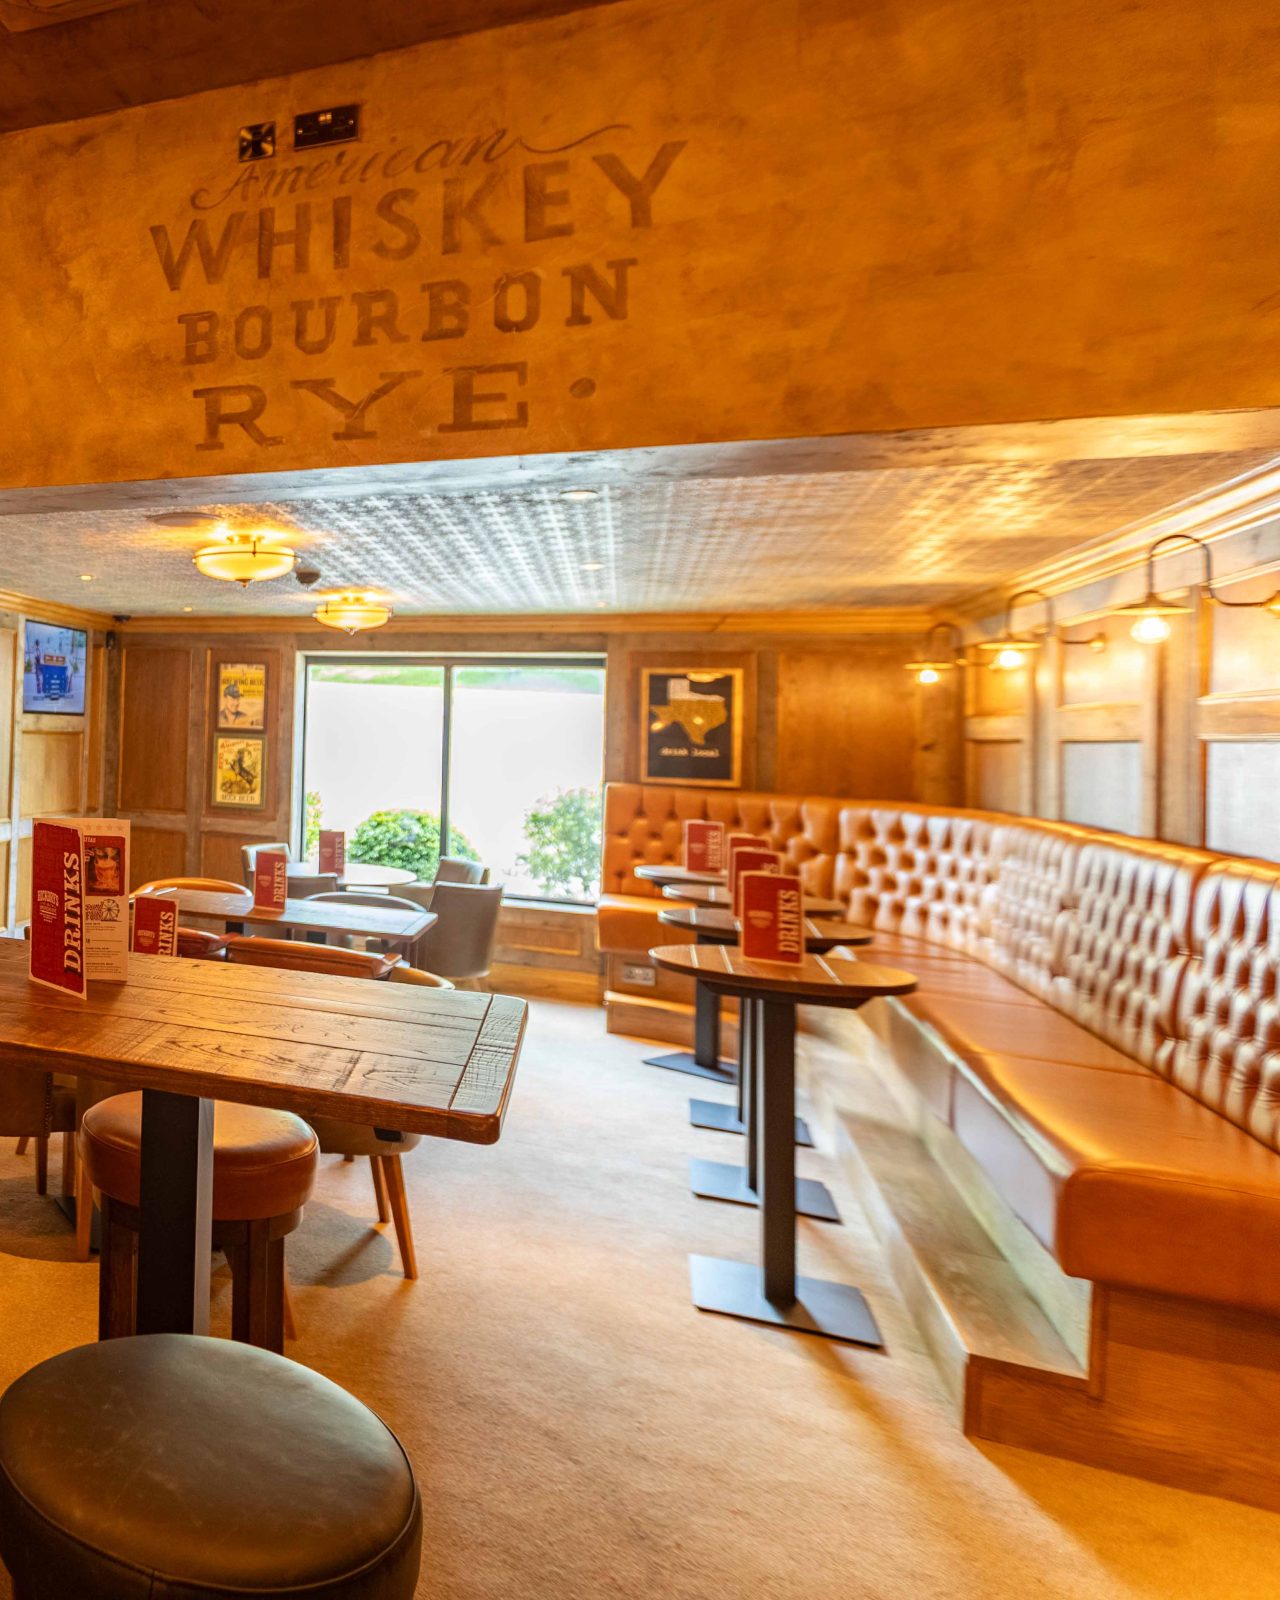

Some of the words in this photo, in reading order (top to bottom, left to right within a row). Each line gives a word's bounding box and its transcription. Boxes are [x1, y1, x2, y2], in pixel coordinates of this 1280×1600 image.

[190, 124, 631, 211] American
[150, 140, 688, 291] WHISKEY
[177, 257, 638, 366] BOURBON
[63, 852, 81, 975] DRINKS
[273, 861, 285, 903] DRINKS
[778, 889, 799, 954] DRINKS
[157, 911, 175, 956] RINKS
